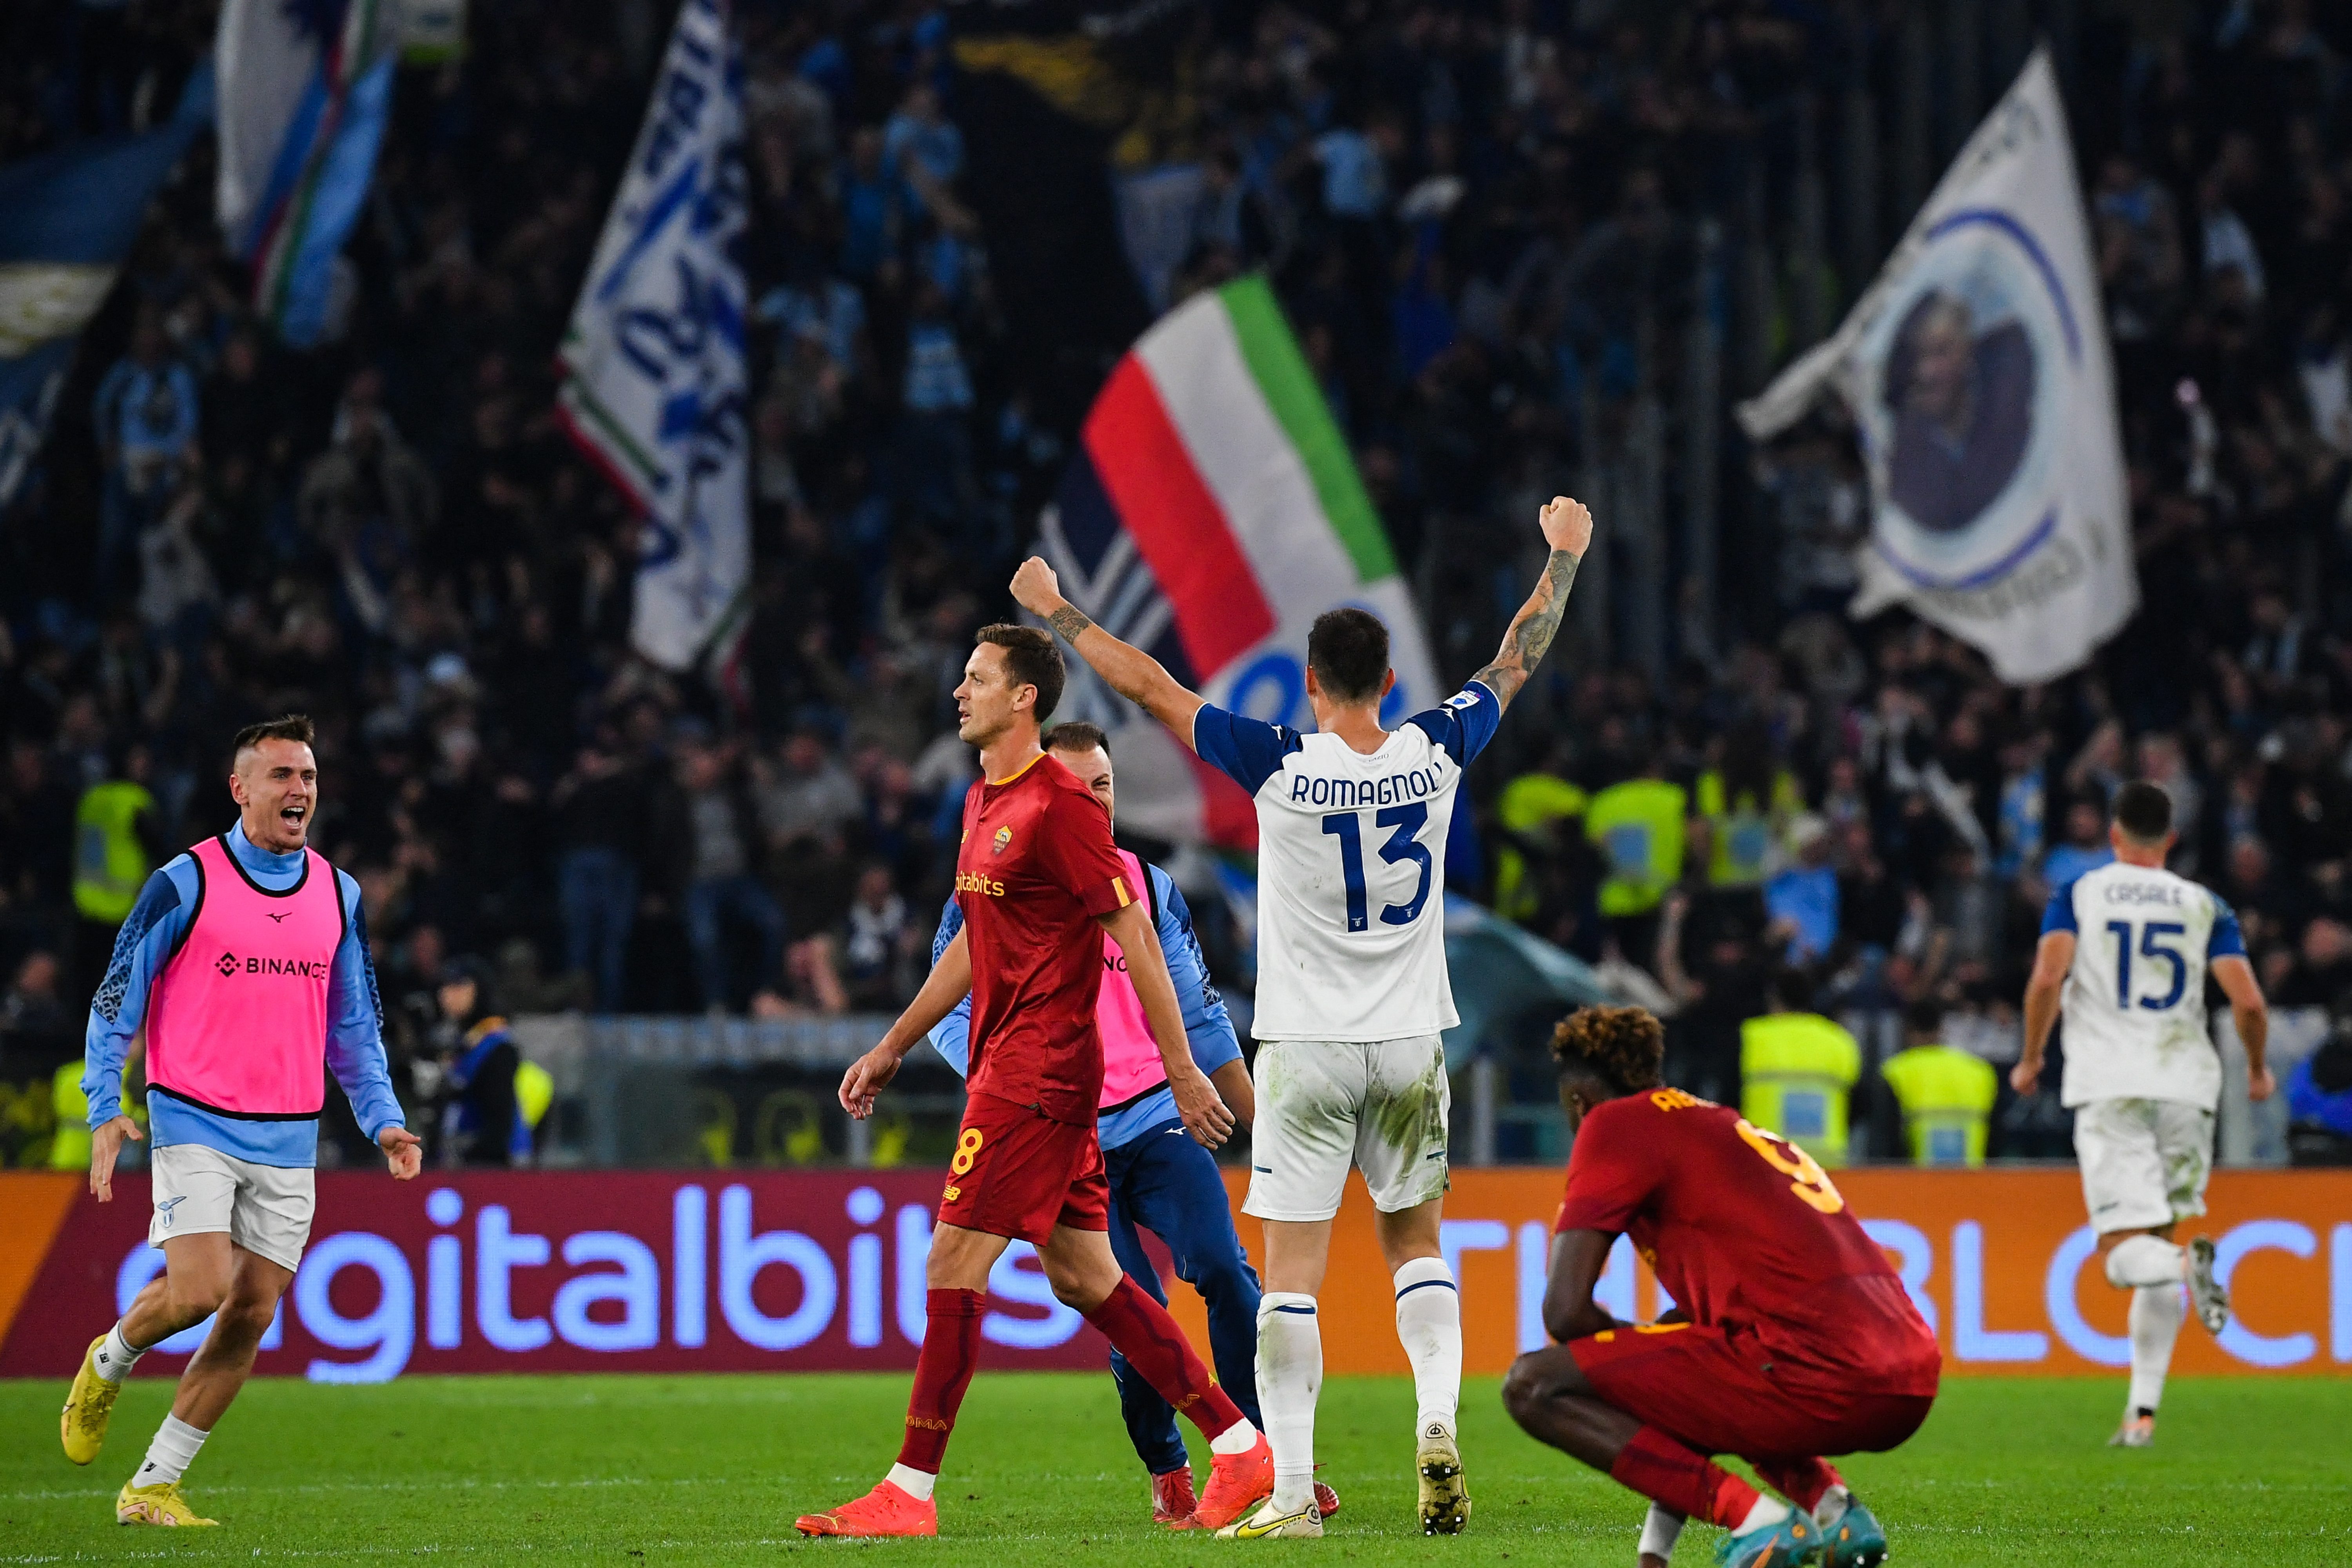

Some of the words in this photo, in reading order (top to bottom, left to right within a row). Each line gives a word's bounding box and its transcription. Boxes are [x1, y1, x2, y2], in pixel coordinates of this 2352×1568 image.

[1292, 761, 1443, 807] ROMAGNOLI
[956, 870, 1005, 897] gitalbits
[1322, 800, 1432, 933] 13
[2104, 882, 2182, 906] CASALE
[246, 957, 327, 980] BINANCE
[2106, 920, 2187, 1011] 15
[952, 1128, 983, 1175] 8
[1733, 1118, 1844, 1214] 9
[115, 1183, 1084, 1384] gitalbits
[905, 1415, 947, 1430] OMA
